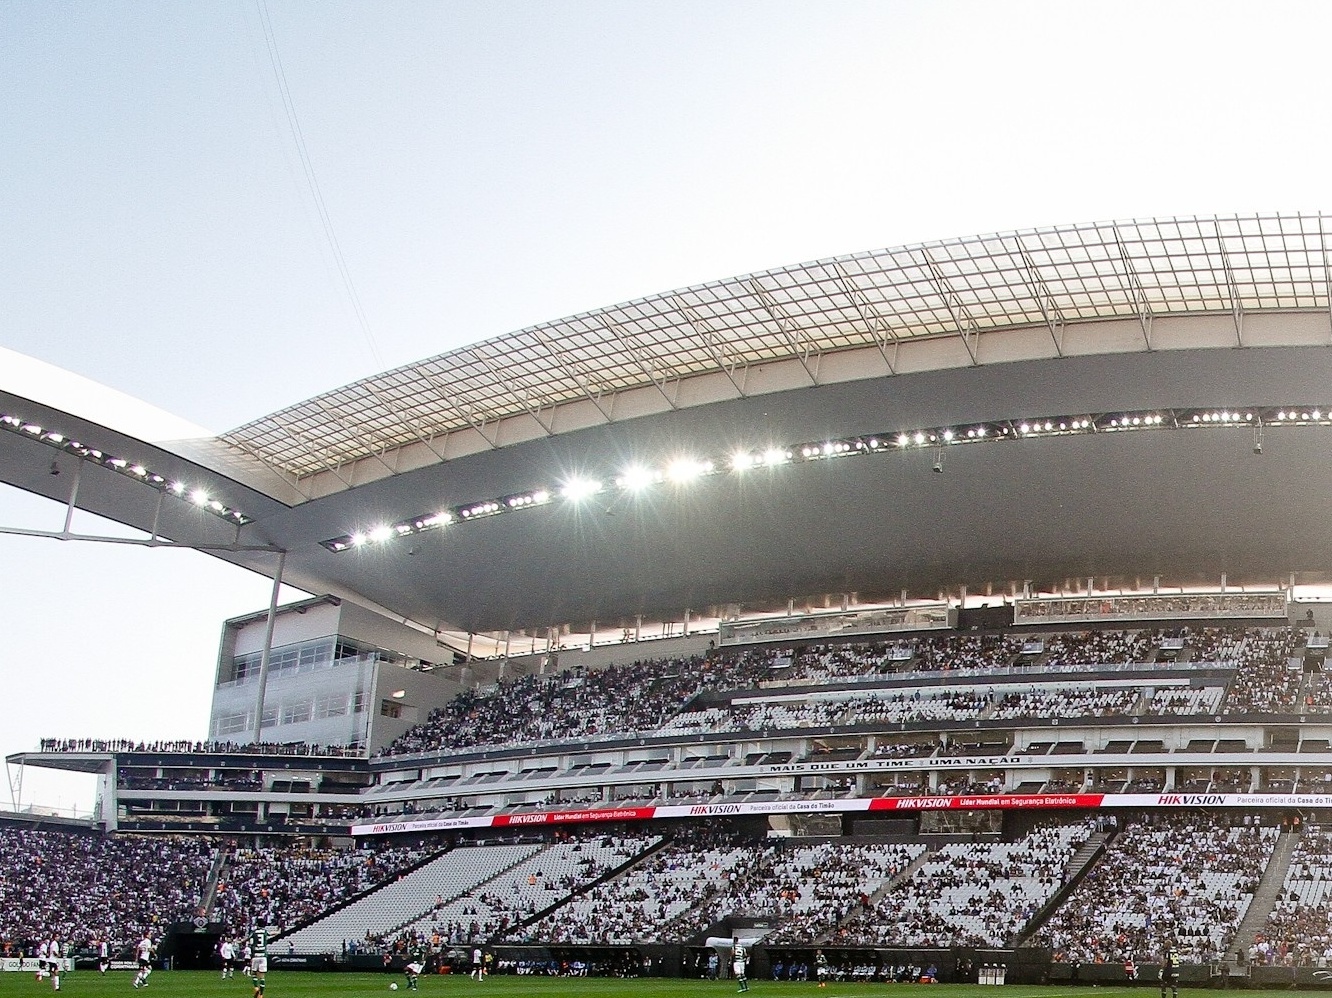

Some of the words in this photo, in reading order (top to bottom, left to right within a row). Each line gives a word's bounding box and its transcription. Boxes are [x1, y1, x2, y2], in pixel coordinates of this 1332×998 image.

[810, 763, 840, 772] QUE
[876, 760, 914, 768] TIME
[929, 758, 964, 766] UMA
[965, 756, 1020, 766] NAÇÃO
[896, 798, 952, 808] HIKVISION
[960, 798, 976, 806] Líder
[976, 798, 999, 806] Mundial
[1011, 798, 1044, 807] Segurança
[1045, 797, 1076, 805] Eletrônica
[1158, 795, 1226, 805] HIKVISION
[1237, 796, 1264, 804] Parceira
[1265, 796, 1286, 804] oficial
[1287, 796, 1296, 804] da
[690, 805, 742, 815] HIKVISION
[509, 814, 548, 824] HIKVISION
[373, 823, 407, 833] HIKVISION
[257, 934, 264, 947] 3
